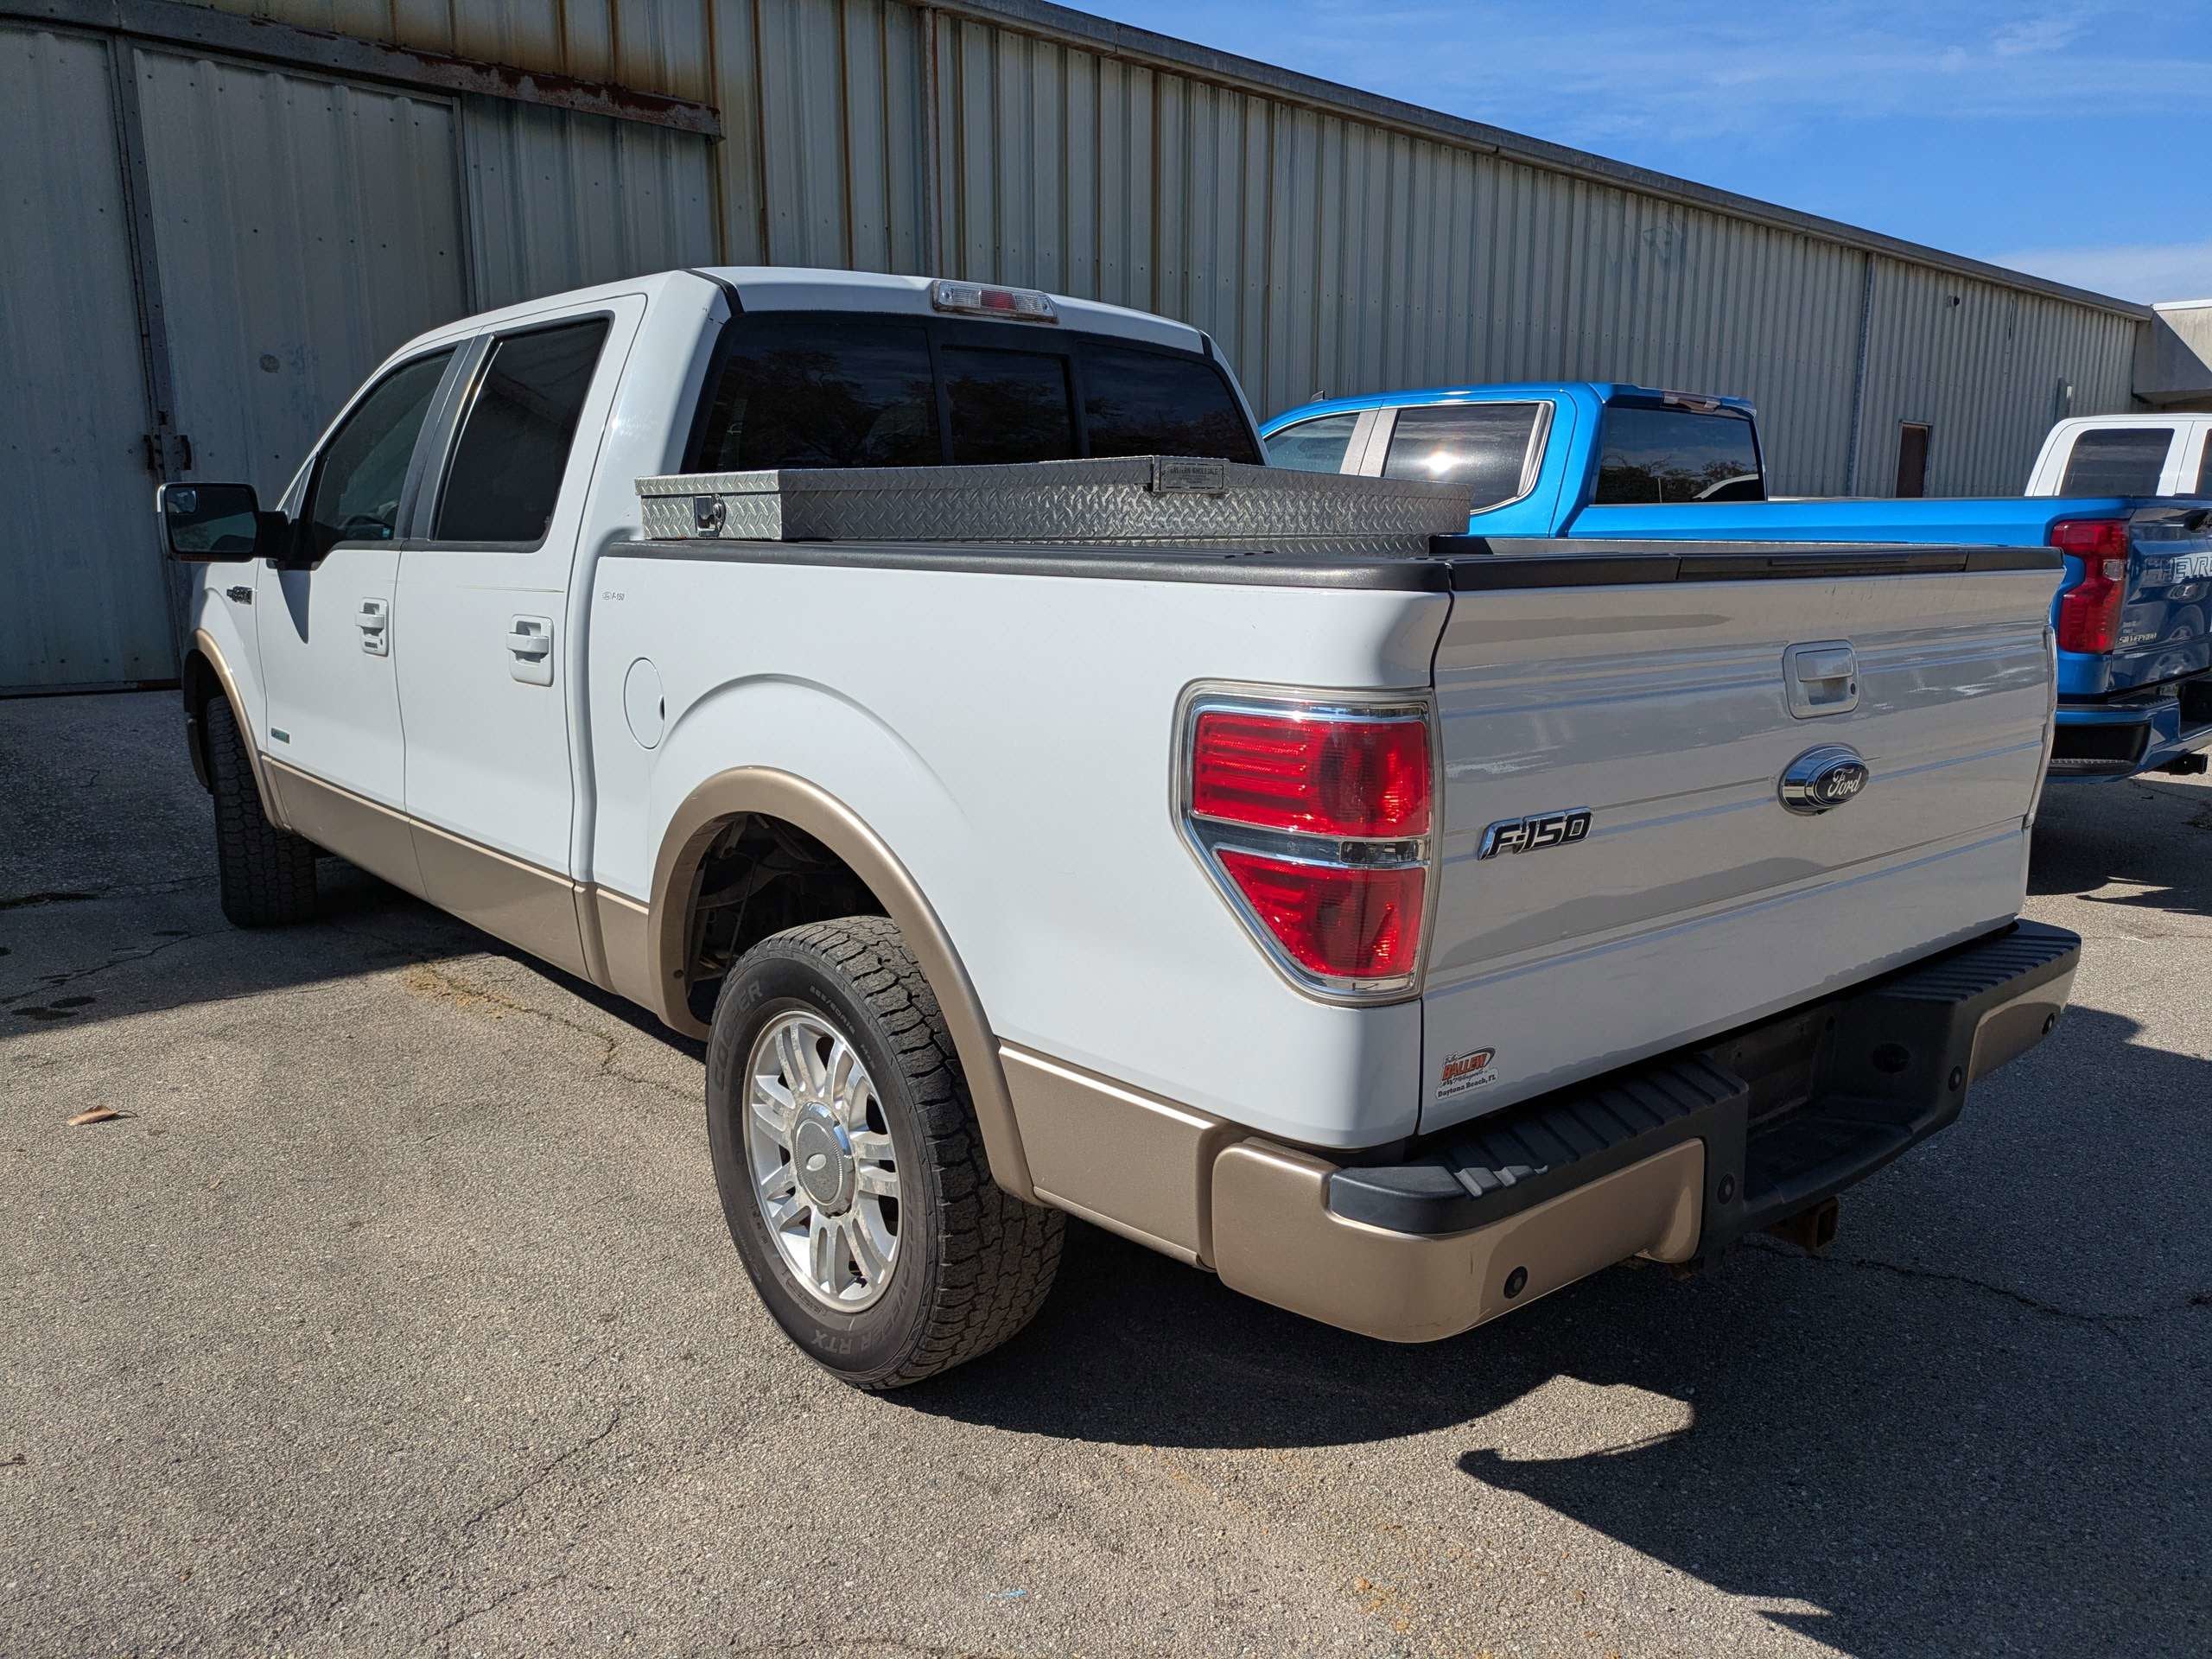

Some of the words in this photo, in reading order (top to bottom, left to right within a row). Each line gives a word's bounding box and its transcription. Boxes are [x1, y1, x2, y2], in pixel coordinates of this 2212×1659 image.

[2145, 556, 2212, 582] CHEVR
[1827, 767, 1863, 798] Ford
[1478, 805, 1593, 861] F-150
[1442, 1053, 1488, 1081] BALLEW
[1437, 1084, 1465, 1097] Daytona
[811, 1329, 852, 1355] RTX
